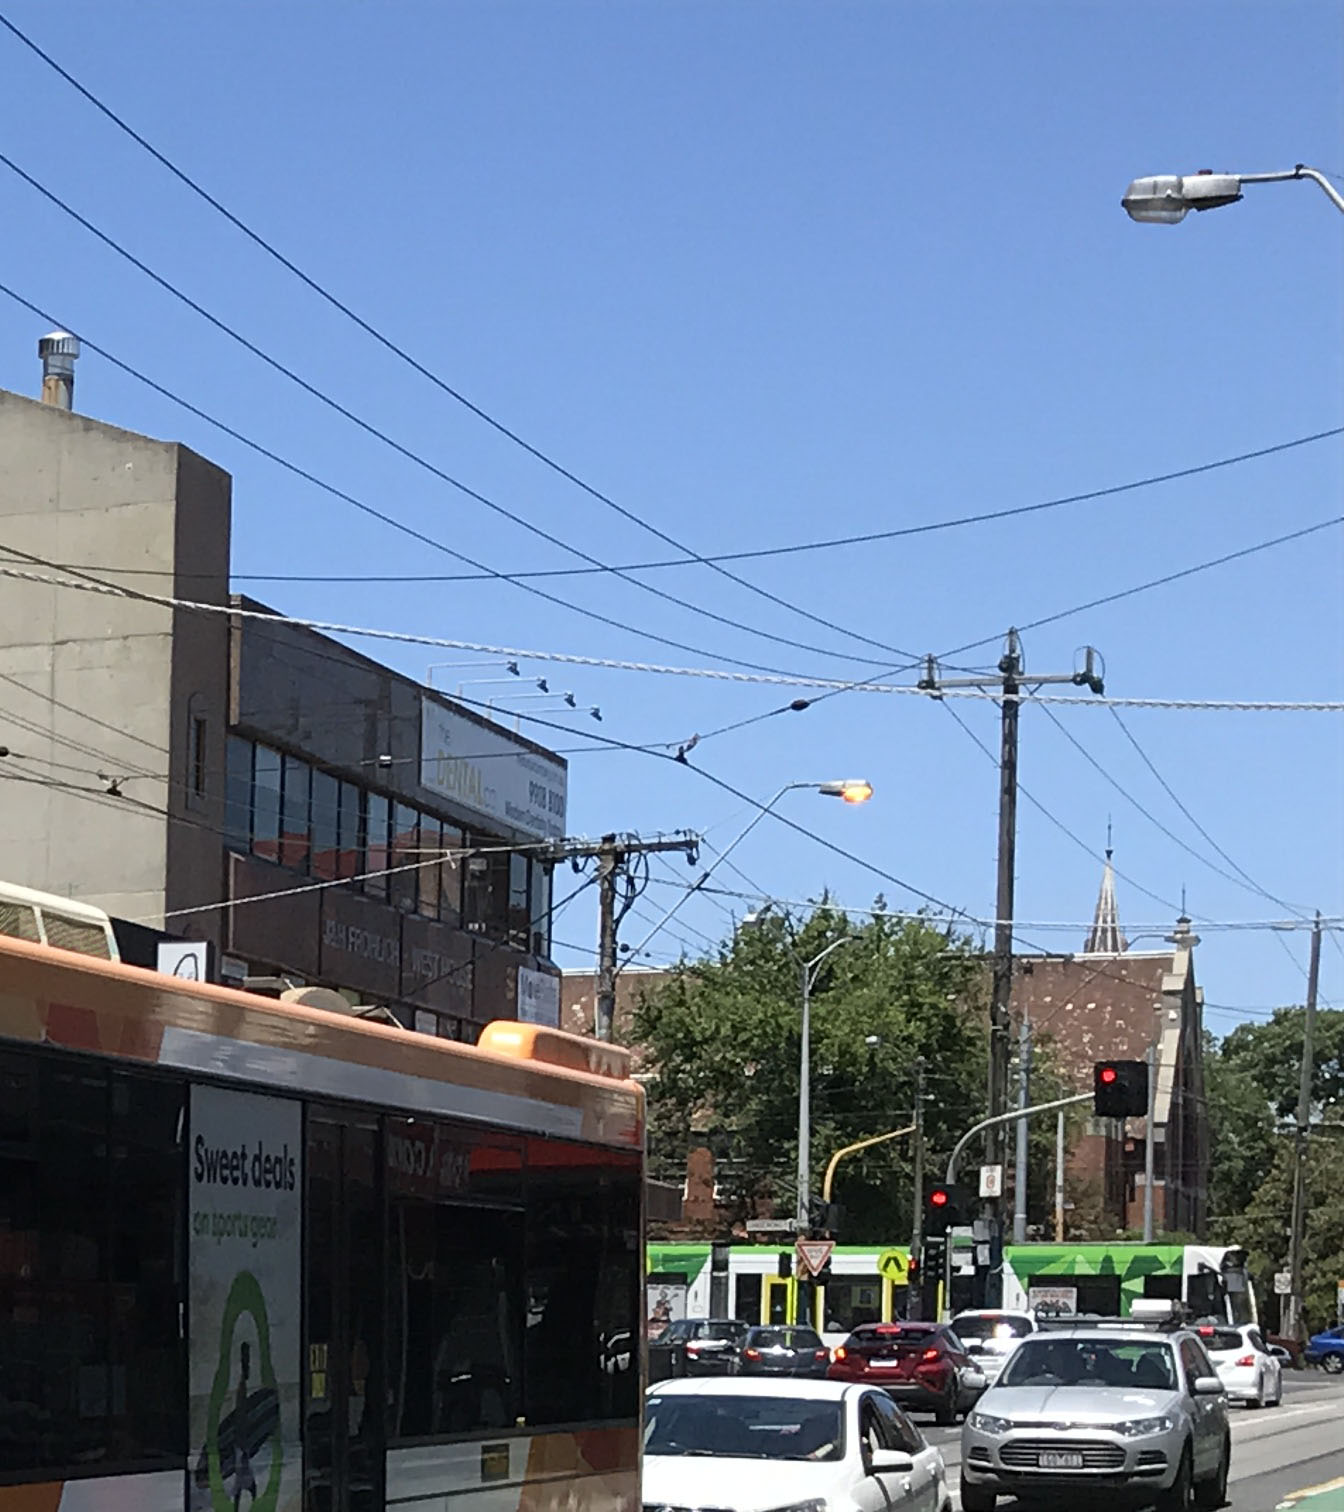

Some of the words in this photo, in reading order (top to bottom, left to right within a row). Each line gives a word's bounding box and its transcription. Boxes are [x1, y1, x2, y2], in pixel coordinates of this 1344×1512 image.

[435, 748, 484, 807] DENTAL
[194, 1133, 249, 1188] Sweet
[251, 1139, 296, 1192] deals
